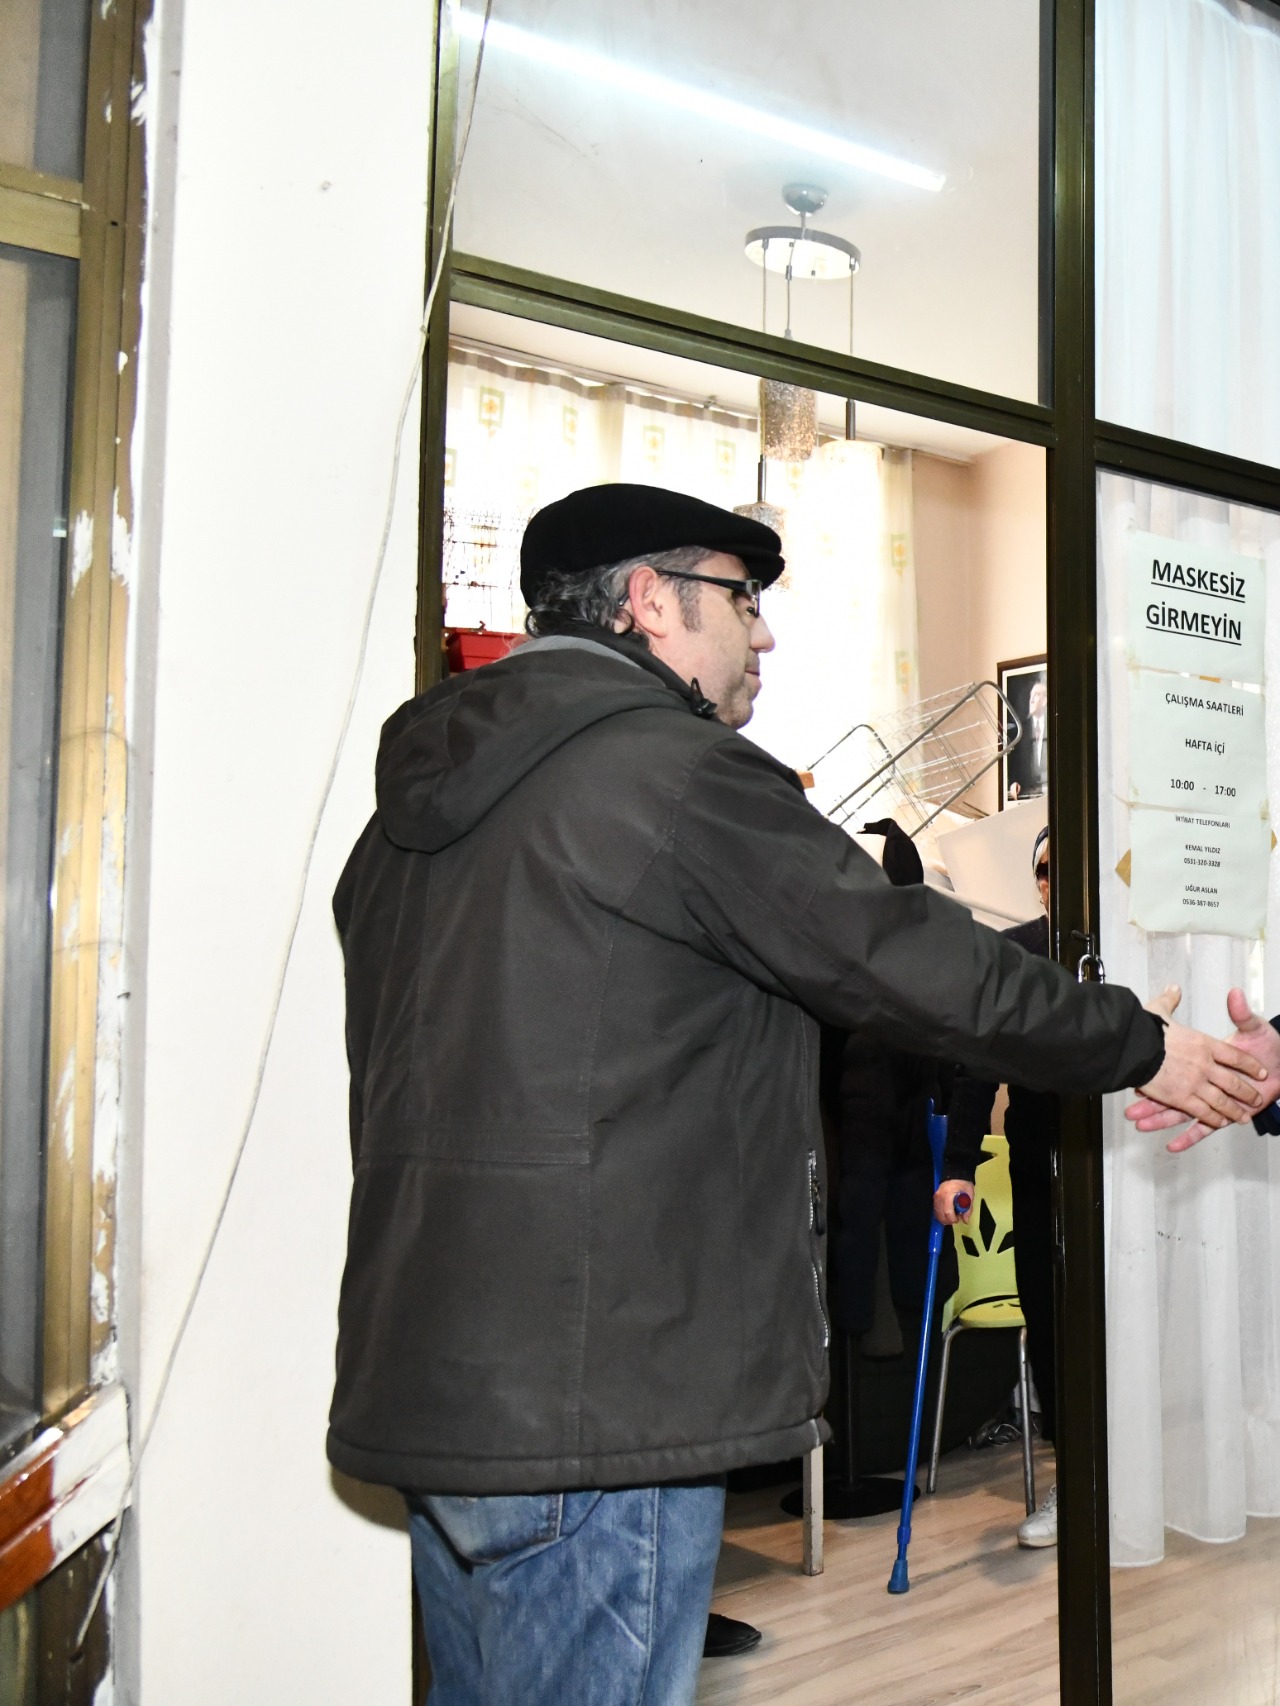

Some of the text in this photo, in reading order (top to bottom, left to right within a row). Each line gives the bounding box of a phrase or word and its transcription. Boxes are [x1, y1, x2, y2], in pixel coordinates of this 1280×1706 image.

[1152, 559, 1246, 598] MASKESİZ
[1146, 601, 1242, 641] GİRMEYİN
[1165, 693, 1244, 717] ÇALIŞMA SAATLERİ
[1185, 738, 1225, 756] HAFTA İÇİ
[1170, 778, 1195, 791] 10:00
[1214, 785, 1236, 798] 17:00
[1196, 818, 1231, 829] TELEFONLARI
